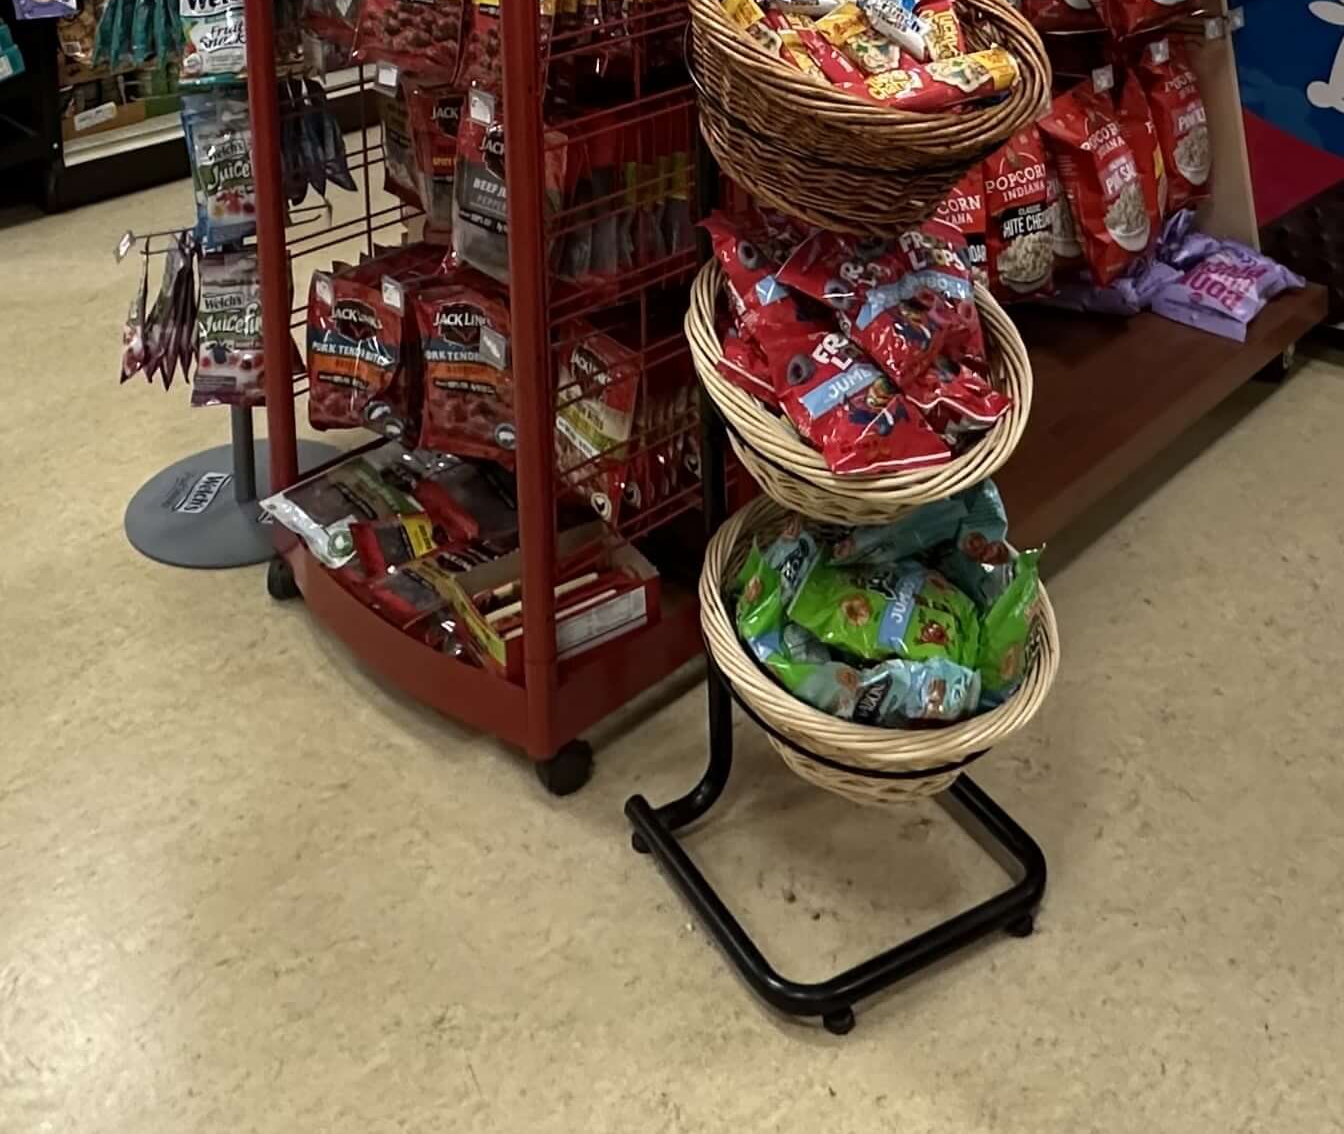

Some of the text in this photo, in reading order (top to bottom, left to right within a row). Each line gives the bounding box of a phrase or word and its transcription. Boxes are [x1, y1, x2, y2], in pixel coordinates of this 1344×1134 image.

[472, 177, 498, 194] BEEF
[1002, 179, 1046, 203] INDIANA
[205, 295, 244, 312] Welch's
[202, 302, 262, 336] Juicefu
[433, 312, 463, 327] JACK
[184, 473, 226, 512] Welch's
